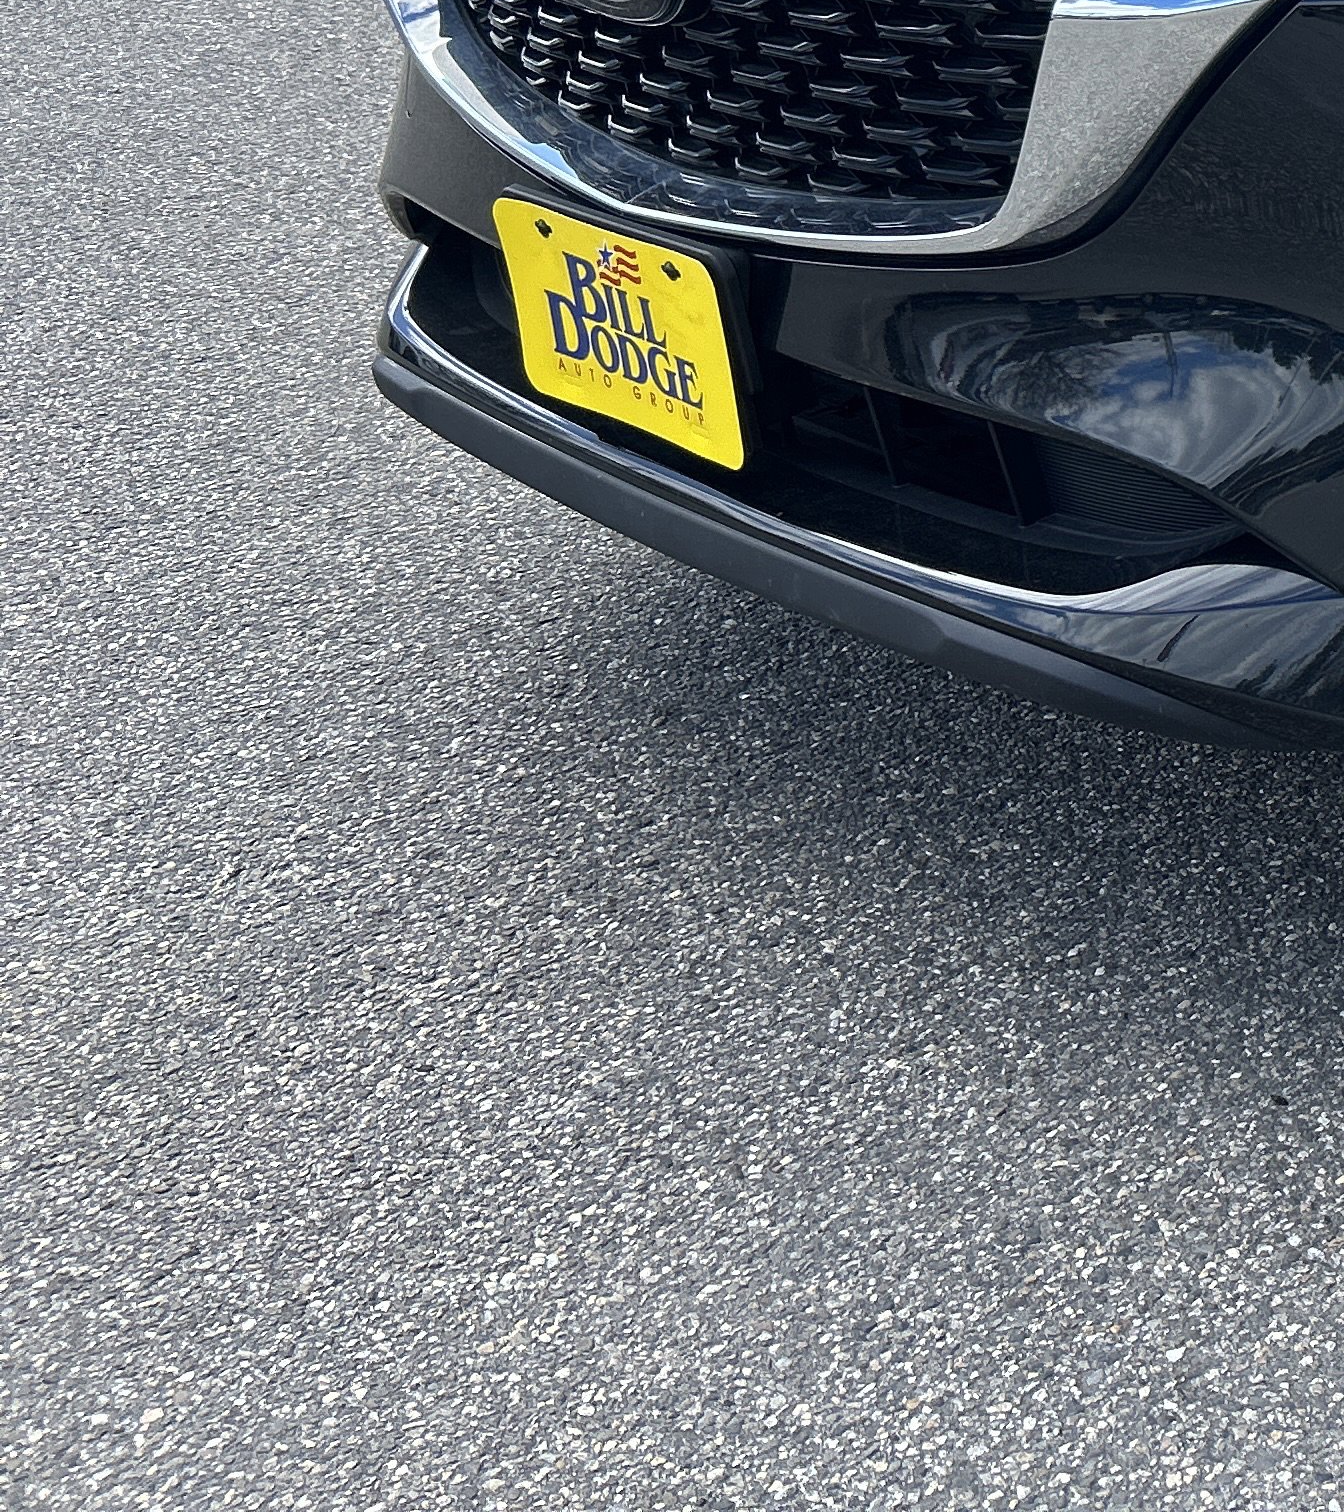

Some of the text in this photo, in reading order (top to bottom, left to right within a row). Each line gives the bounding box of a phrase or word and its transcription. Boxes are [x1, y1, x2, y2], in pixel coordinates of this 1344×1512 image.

[562, 251, 667, 348] BILL
[544, 289, 703, 410] DODGE
[558, 357, 705, 426] AUTO GROUP
